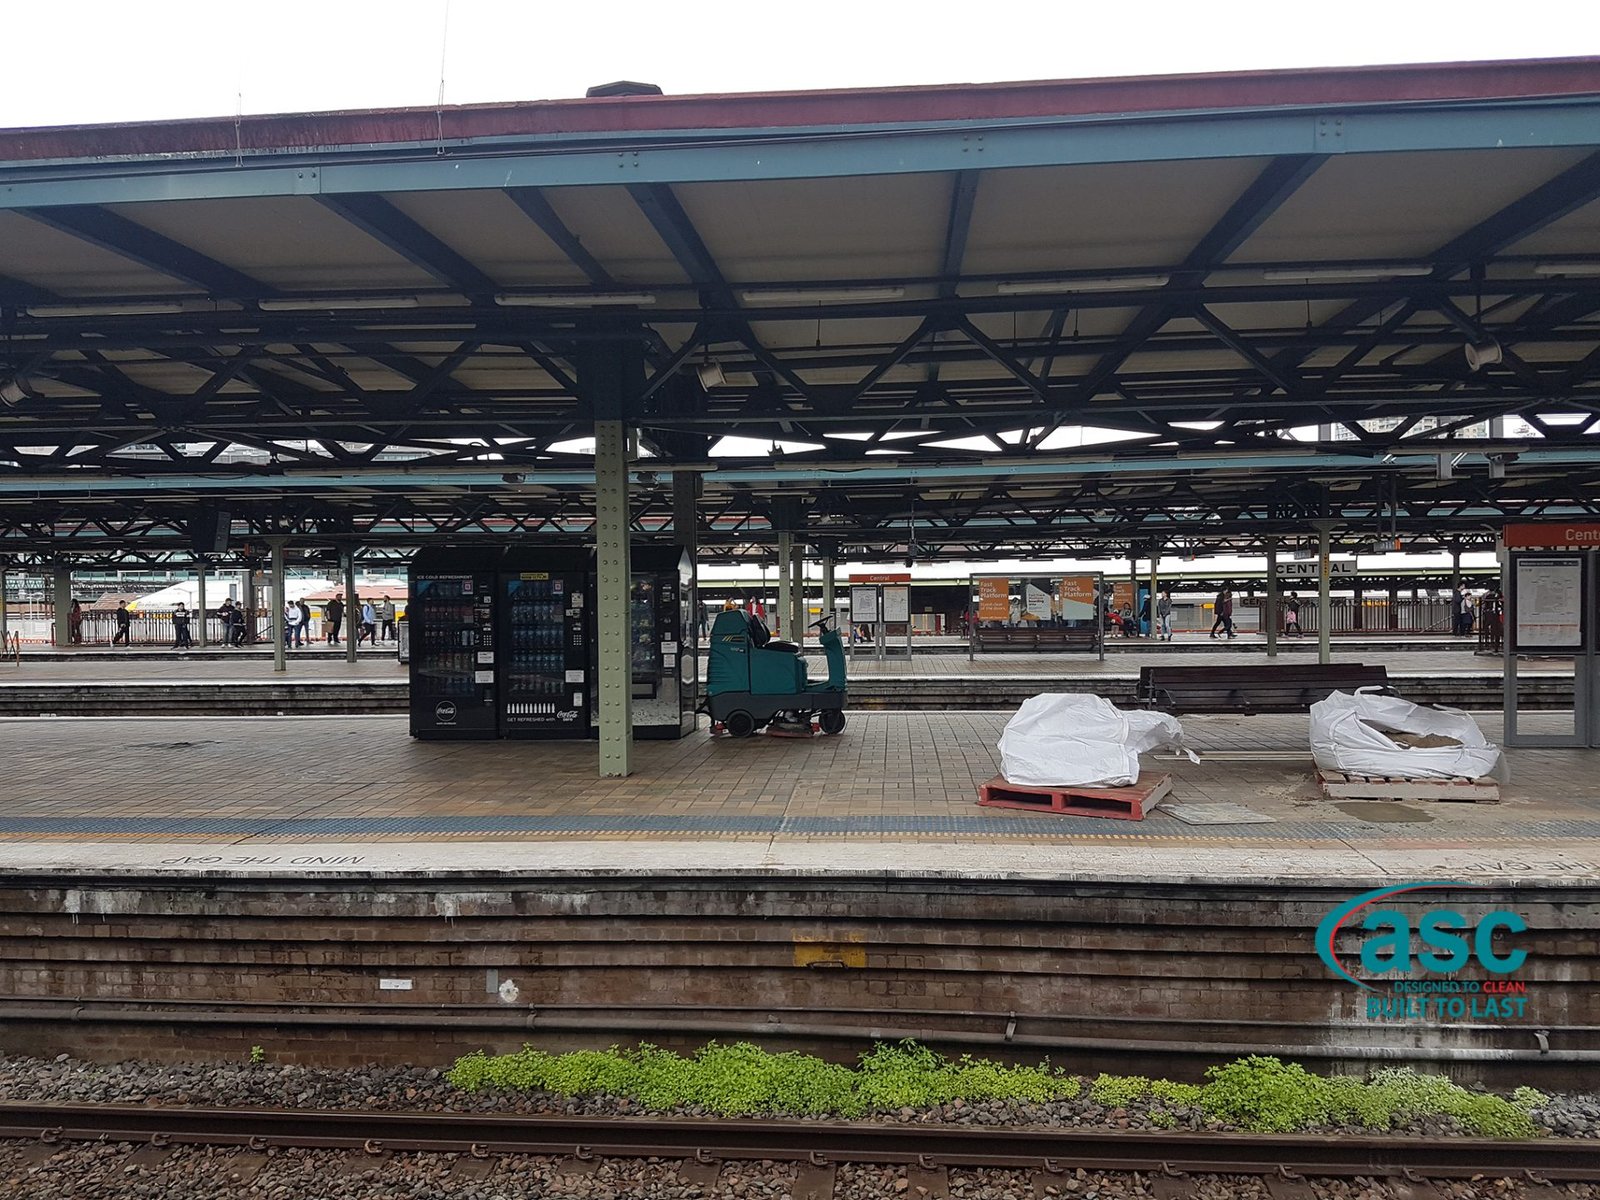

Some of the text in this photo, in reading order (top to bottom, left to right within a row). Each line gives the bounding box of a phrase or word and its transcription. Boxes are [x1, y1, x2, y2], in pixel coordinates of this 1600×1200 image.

[1565, 528, 1600, 541] Cent
[1276, 563, 1351, 574] CENTAL
[161, 856, 365, 864] MIND THE GAP
